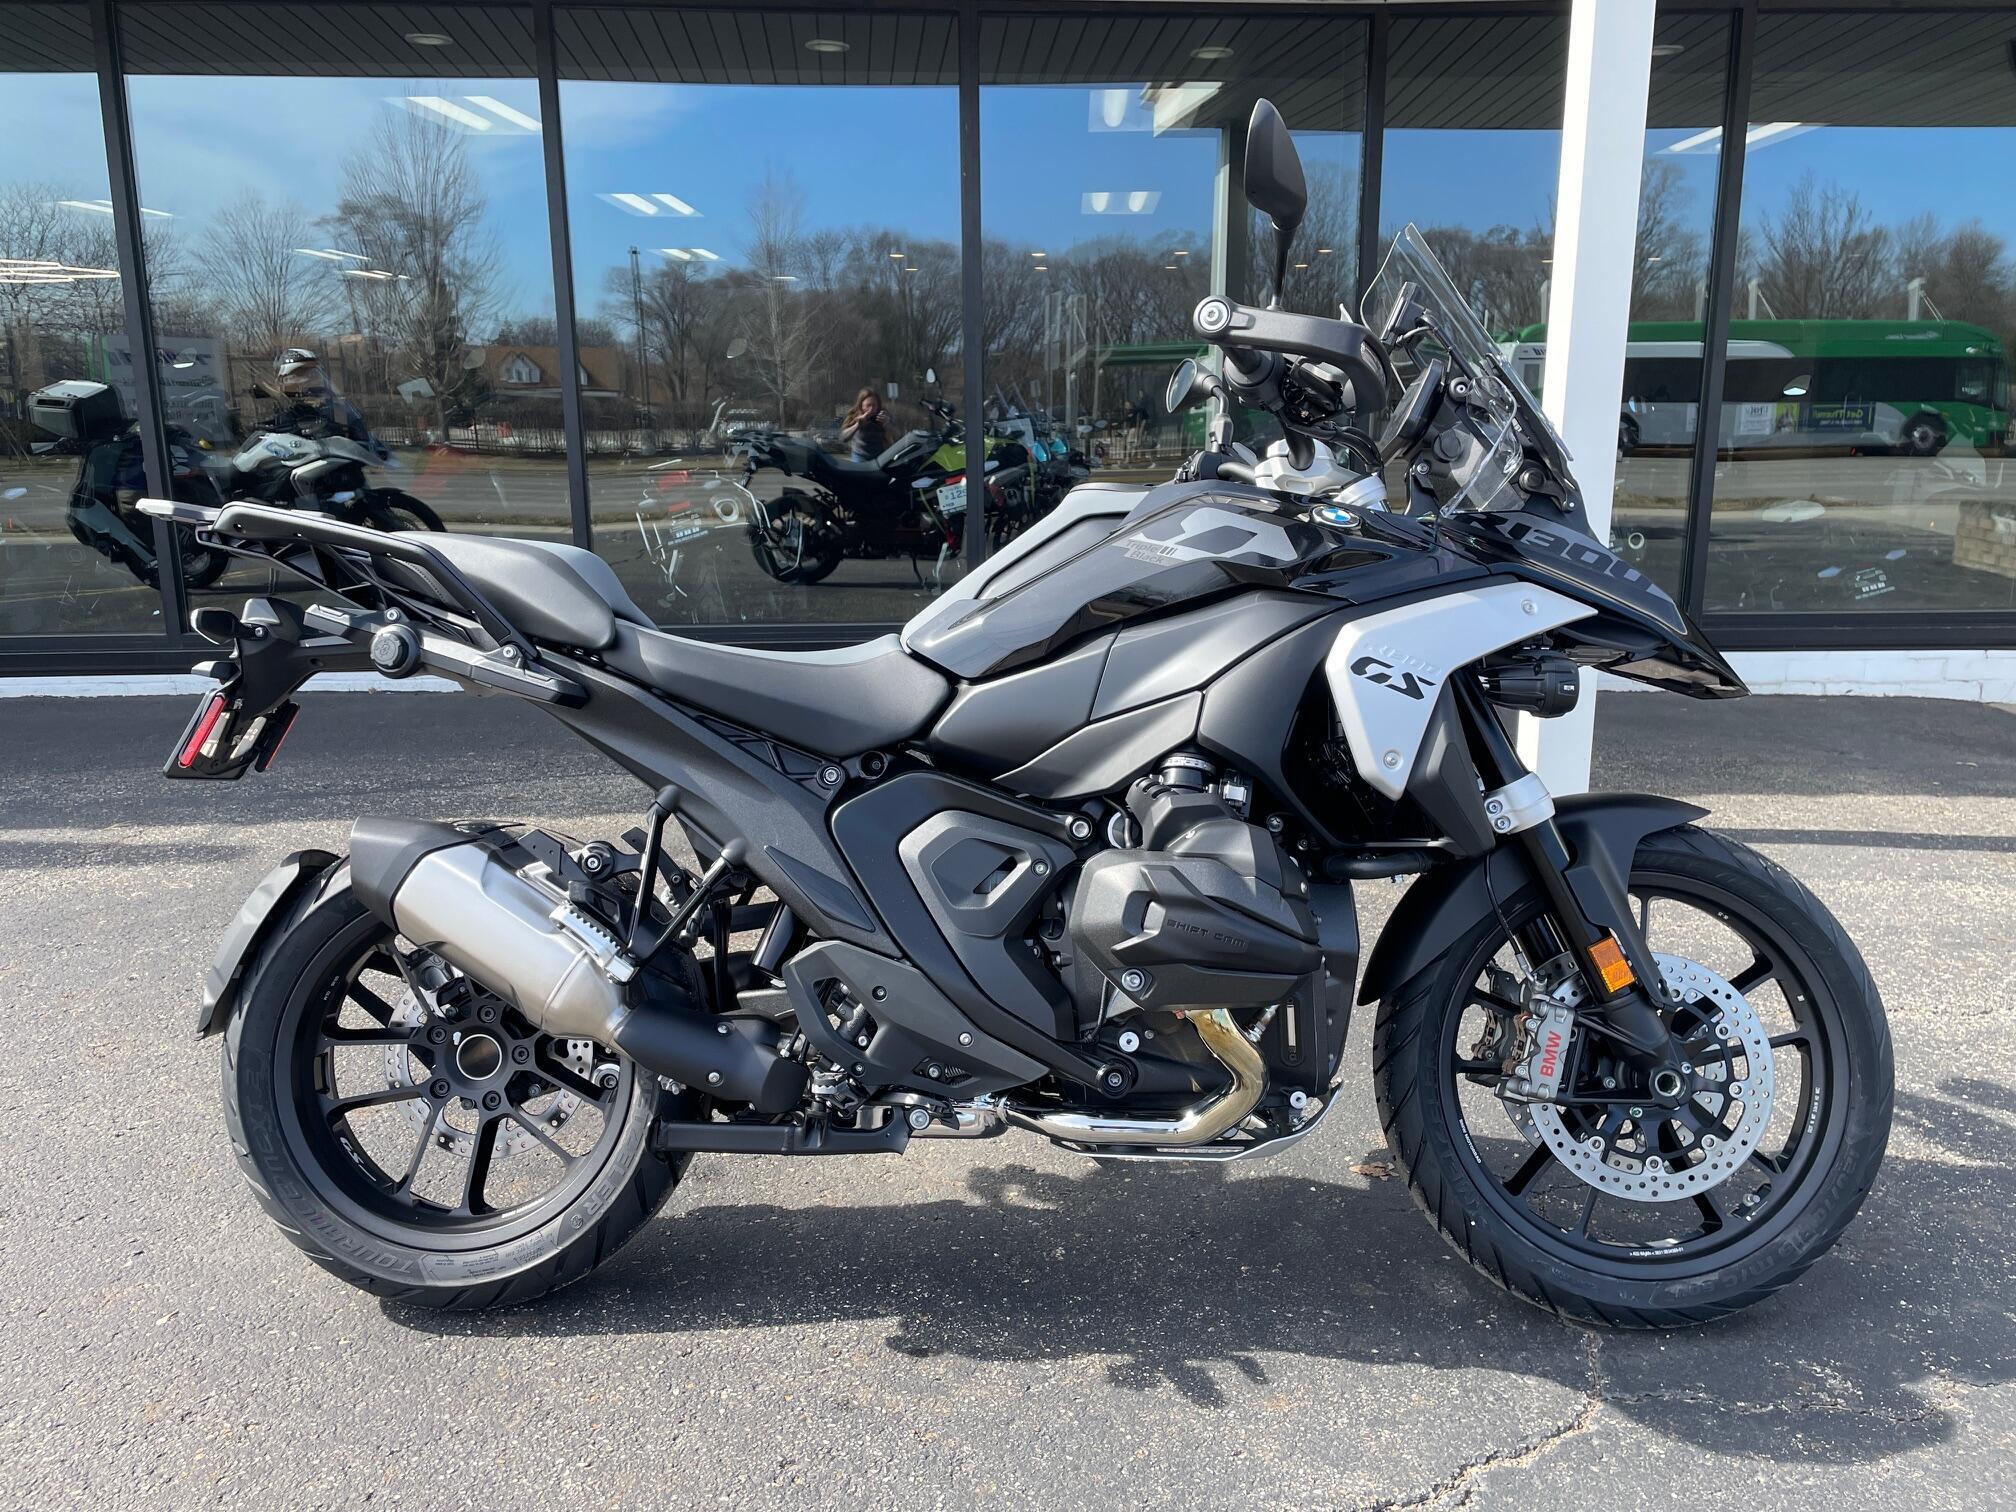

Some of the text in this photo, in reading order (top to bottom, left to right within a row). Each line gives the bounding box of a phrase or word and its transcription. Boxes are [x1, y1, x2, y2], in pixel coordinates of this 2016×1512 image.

[1125, 539, 1160, 553] Triple
[1130, 550, 1165, 565] Black
[1350, 656, 1437, 700] GS
[1166, 919, 1247, 950] SHIFT CAM
[1540, 1030, 1561, 1077] BMW
